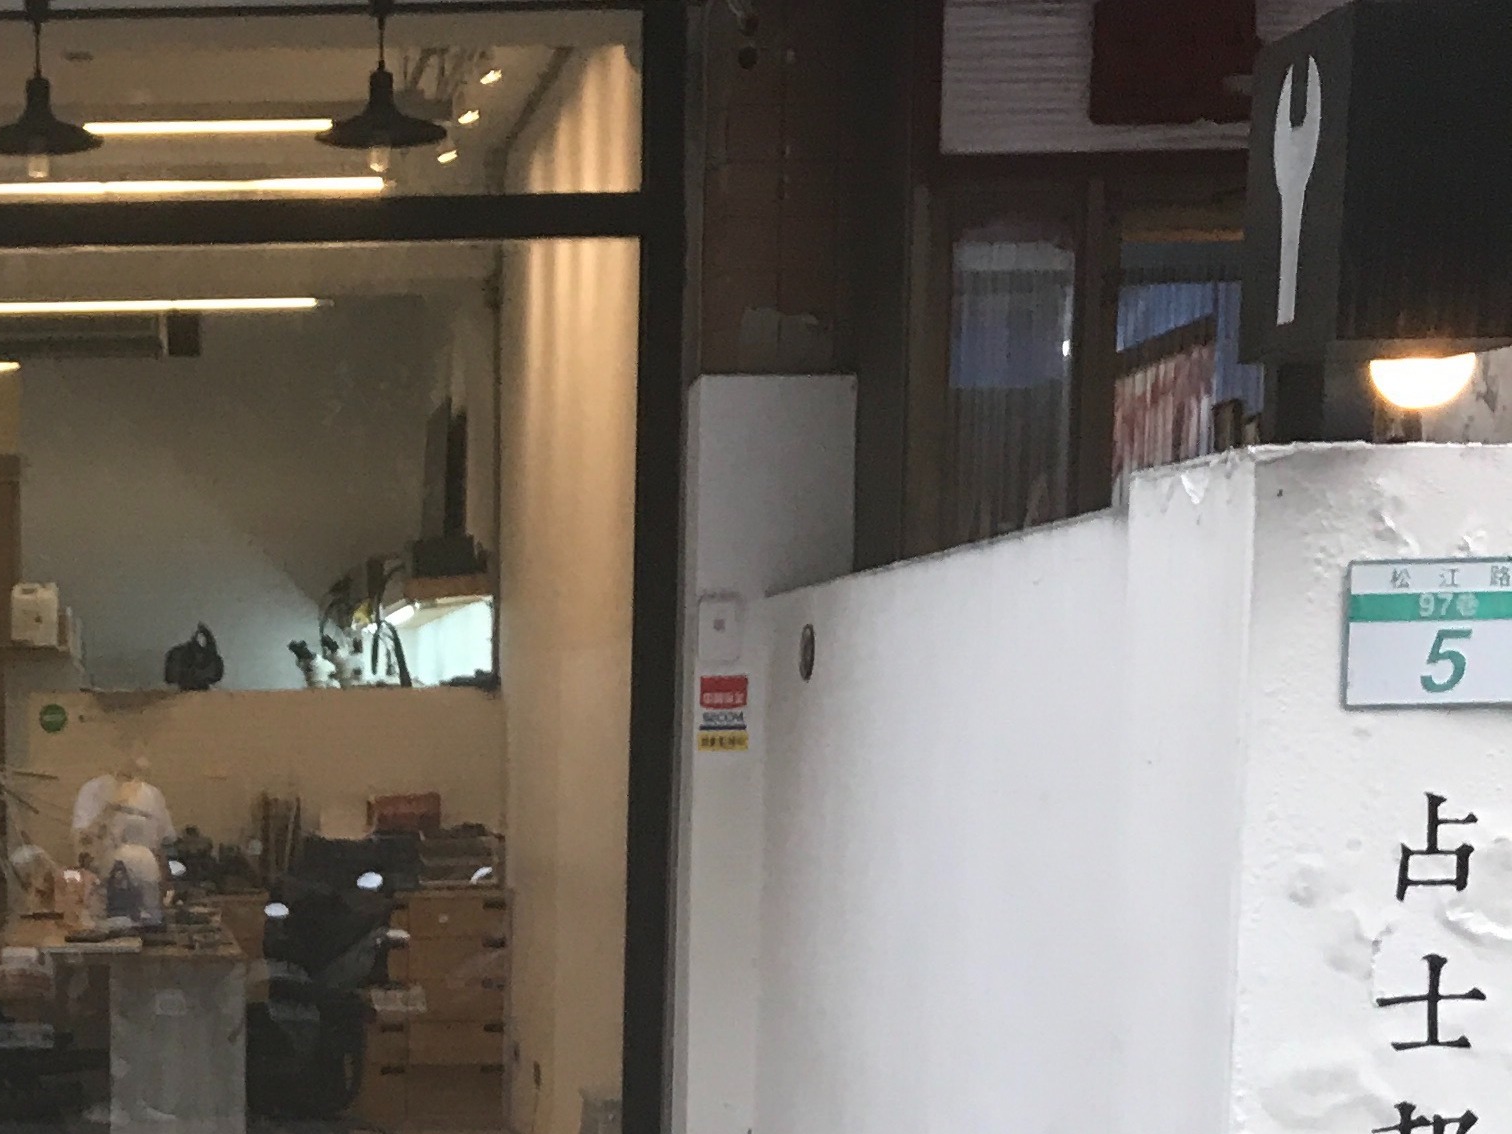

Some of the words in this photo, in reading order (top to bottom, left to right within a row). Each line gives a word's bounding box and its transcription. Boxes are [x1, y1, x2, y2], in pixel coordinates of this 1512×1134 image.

[1391, 565, 1511, 589] 松江路
[1420, 628, 1473, 693] 5
